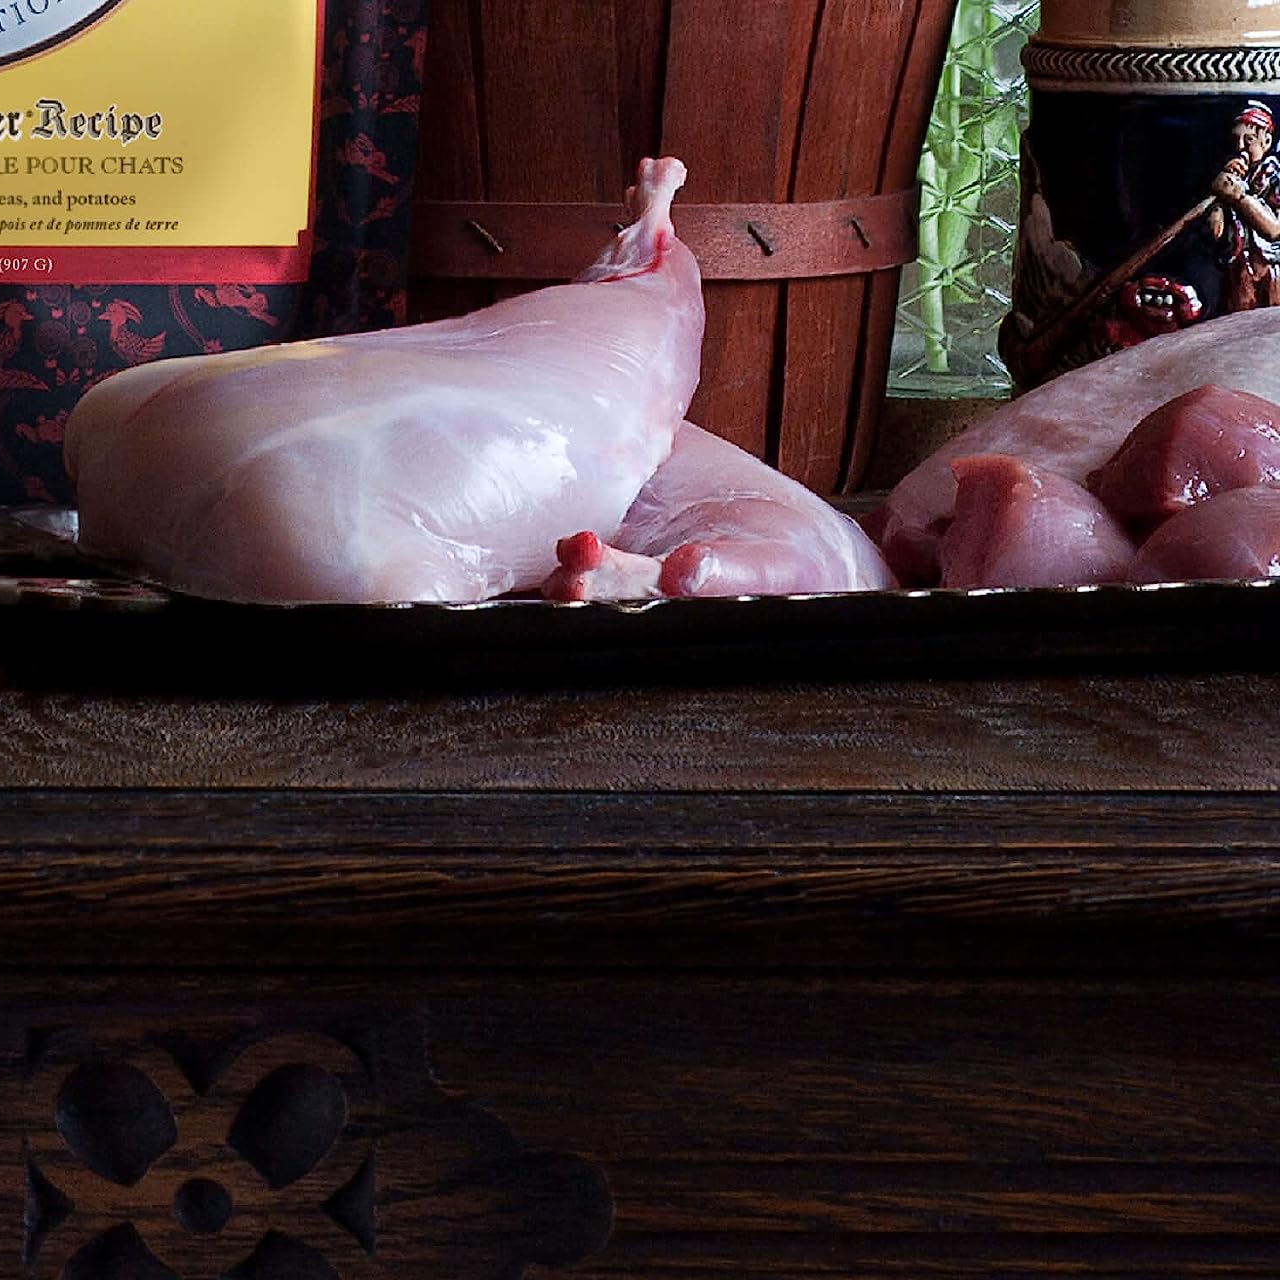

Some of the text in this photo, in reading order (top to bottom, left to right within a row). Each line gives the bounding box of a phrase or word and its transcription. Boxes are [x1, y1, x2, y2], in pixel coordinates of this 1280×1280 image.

[31, 99, 162, 145] Recipe
[26, 157, 95, 174] POUR
[101, 157, 184, 174] CHATS
[32, 190, 62, 205] and
[67, 193, 136, 211] potatoes
[29, 219, 43, 231] et
[45, 218, 62, 231] de
[65, 220, 121, 235] pommes
[125, 218, 141, 231] de
[145, 220, 179, 231] terre
[33, 258, 53, 274] G)
